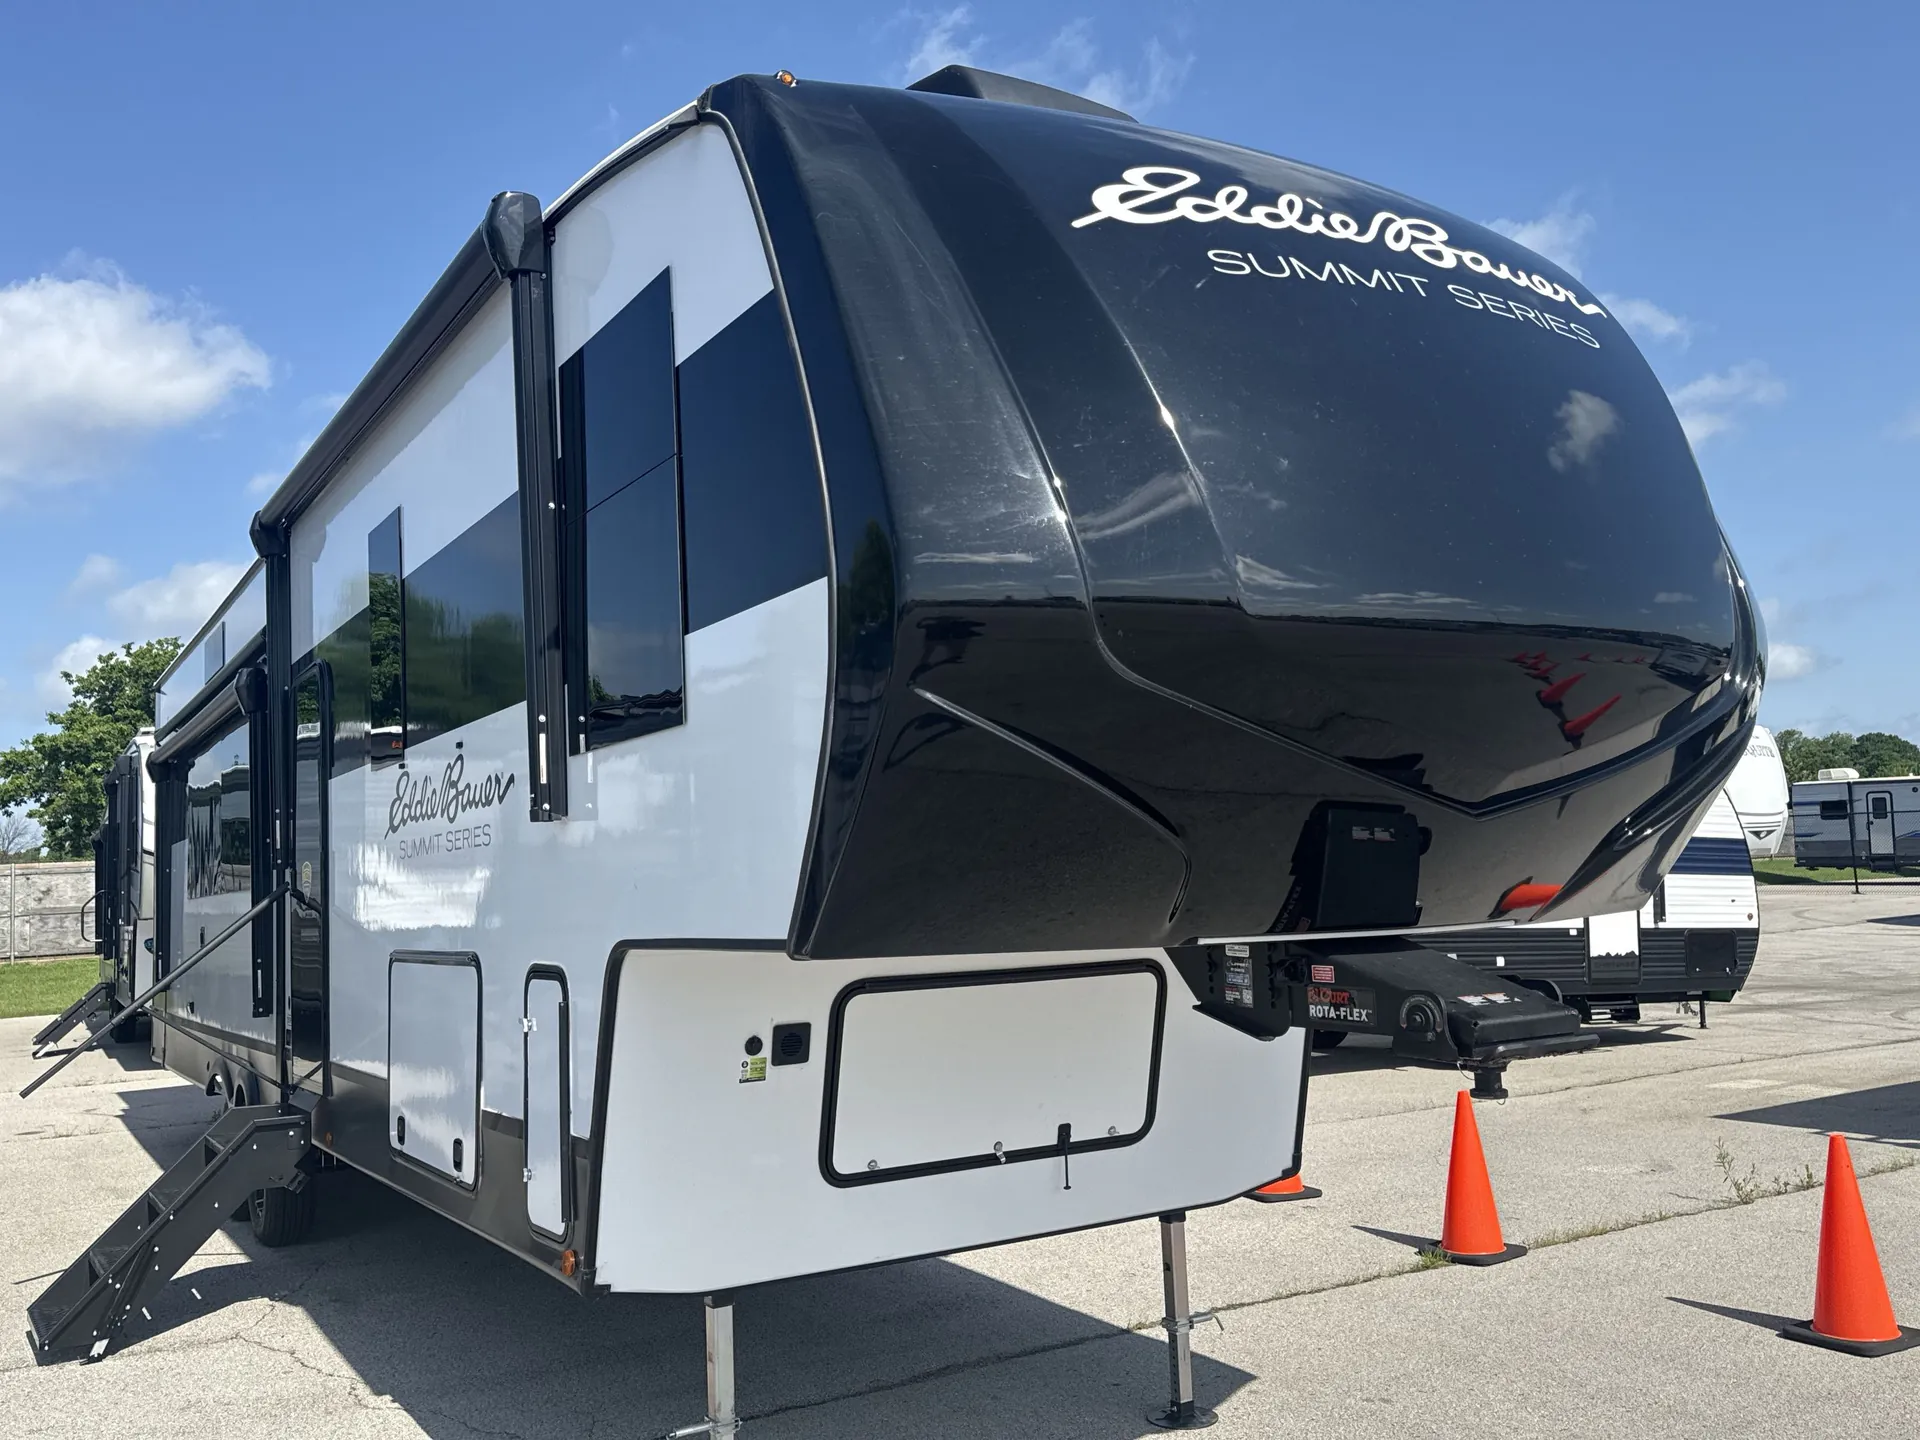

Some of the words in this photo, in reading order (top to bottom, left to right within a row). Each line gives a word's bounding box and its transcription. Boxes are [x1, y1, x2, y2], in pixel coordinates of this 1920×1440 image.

[1072, 166, 1376, 243] Eddie
[1374, 211, 1607, 317] Bauer
[1207, 249, 1428, 297] SUMMIT
[1447, 284, 1600, 349] SERIES
[384, 771, 437, 840] Eddie
[437, 753, 515, 824] Bauer
[400, 833, 442, 859] SUMMIT
[446, 823, 491, 852] SERIES
